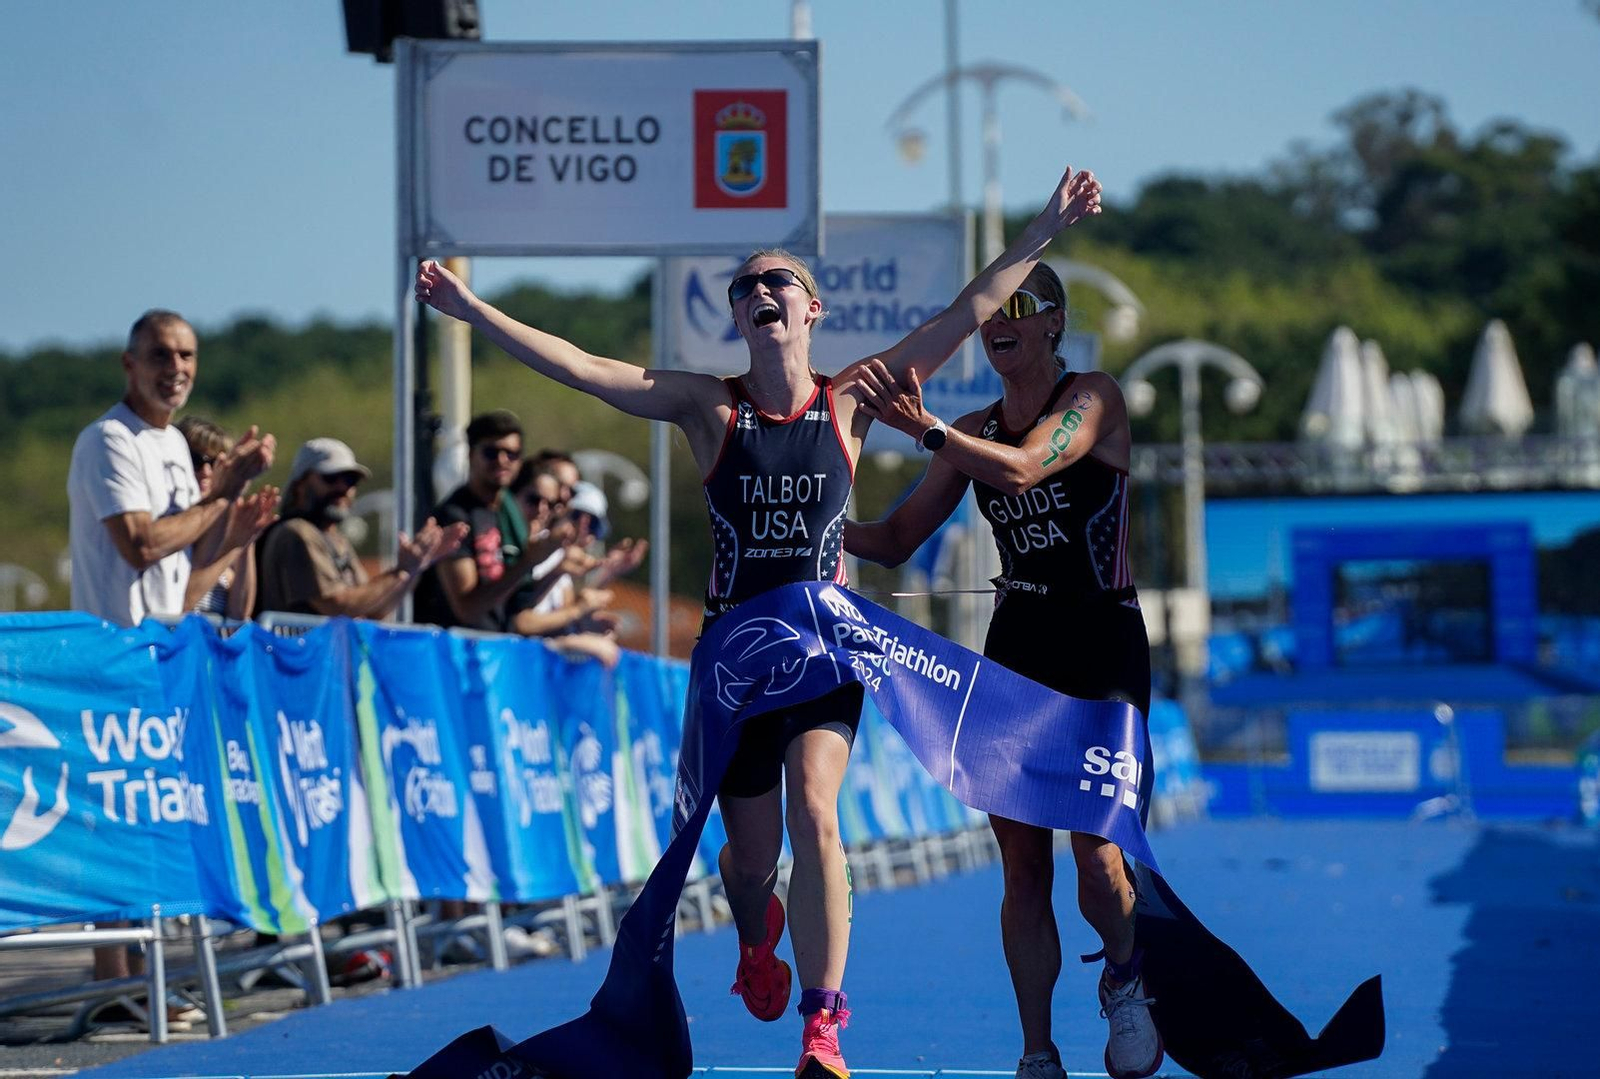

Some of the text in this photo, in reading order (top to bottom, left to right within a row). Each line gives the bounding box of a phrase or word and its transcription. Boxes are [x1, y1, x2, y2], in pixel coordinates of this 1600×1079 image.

[464, 115, 661, 145] CONCELLO
[488, 154, 638, 183] DE VIGO
[814, 257, 897, 292] orld
[739, 473, 827, 504] TALBOT
[989, 482, 1071, 524] GUIDE
[752, 510, 809, 540] USA
[1011, 519, 1069, 554] USA
[1083, 745, 1143, 794] sa
